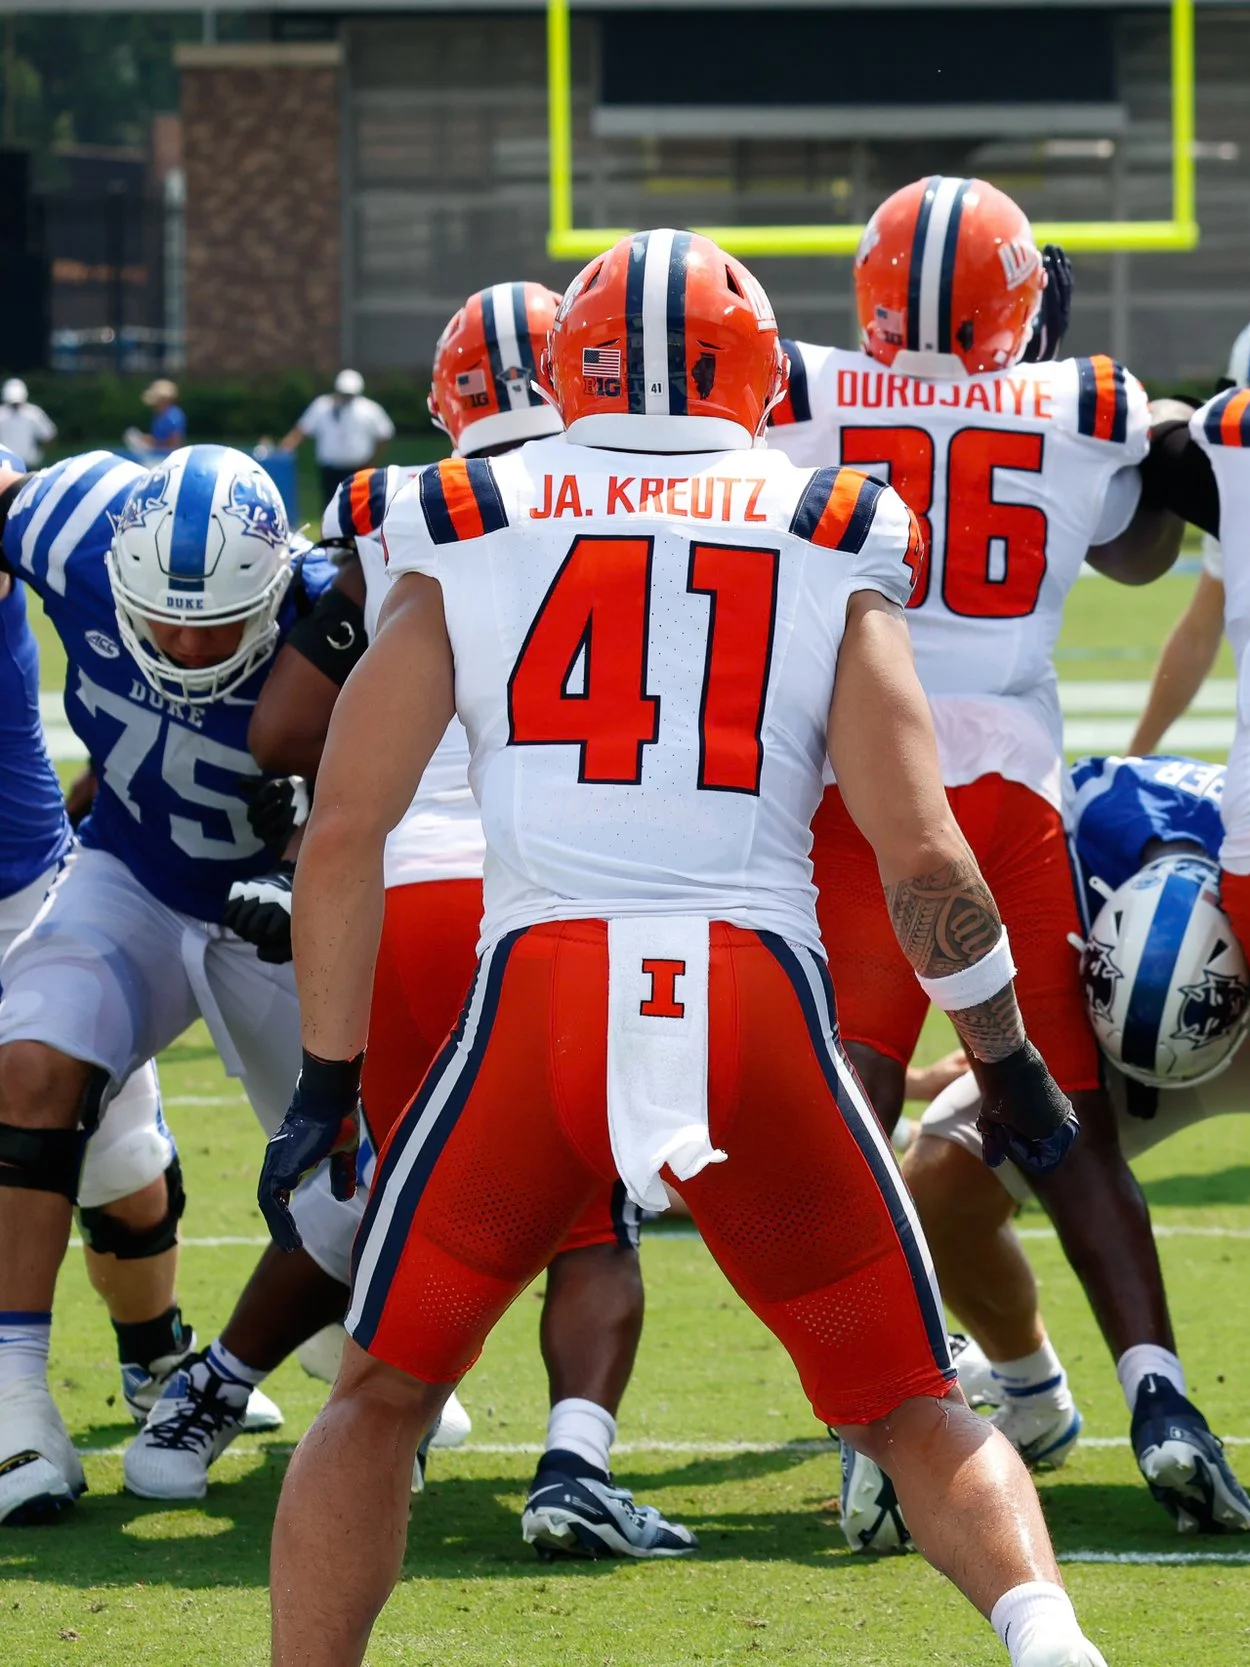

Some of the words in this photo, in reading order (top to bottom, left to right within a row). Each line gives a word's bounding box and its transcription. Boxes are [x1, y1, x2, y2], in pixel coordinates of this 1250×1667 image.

[651, 382, 662, 394] 41
[529, 473, 593, 520] JA.
[606, 476, 767, 522] KREUTZ
[839, 424, 1048, 619] 36
[165, 595, 204, 611] DUKE
[506, 533, 781, 797] 41
[128, 678, 206, 729] DUKE
[74, 663, 268, 862] 75
[640, 957, 686, 1019] I
